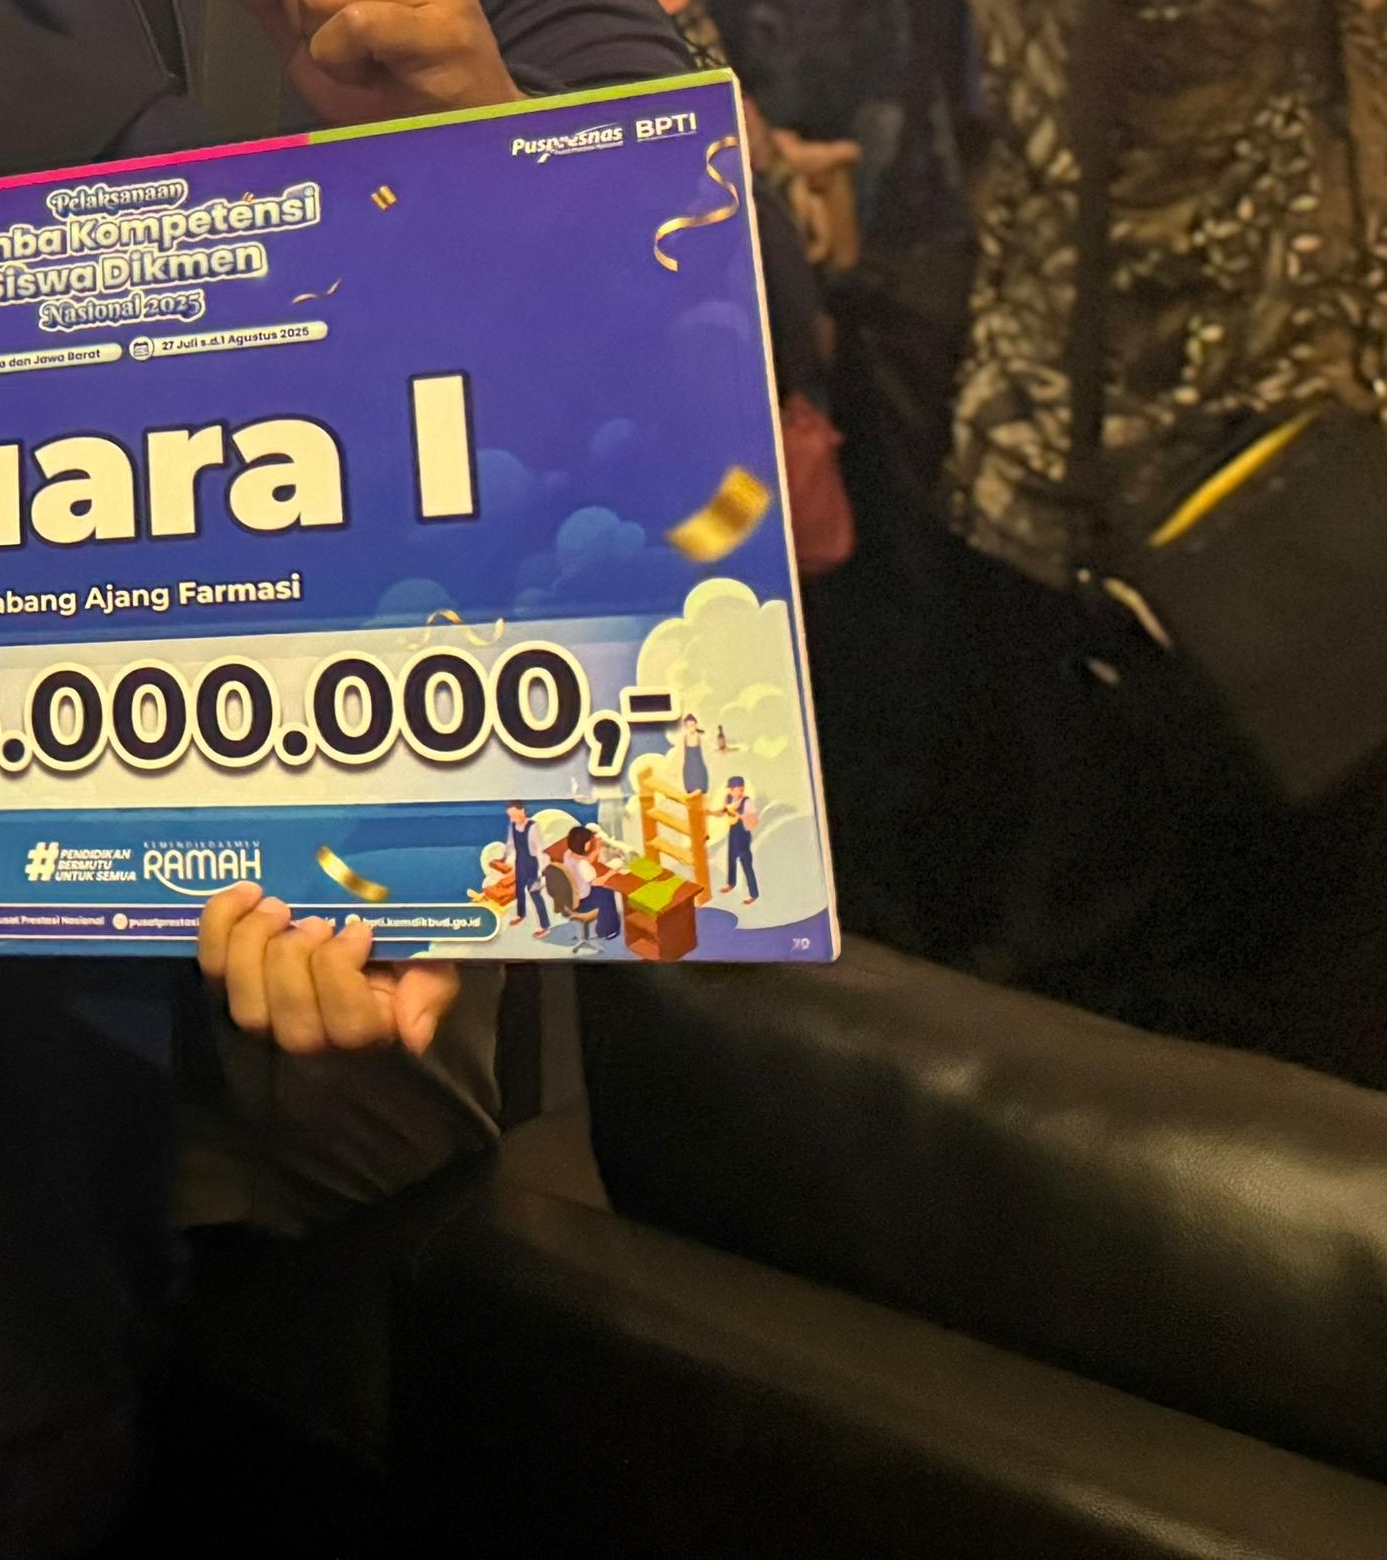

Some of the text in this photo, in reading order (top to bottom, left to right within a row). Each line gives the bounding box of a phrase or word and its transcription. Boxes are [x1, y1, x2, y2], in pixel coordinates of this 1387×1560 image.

[635, 112, 697, 138] BPTI
[50, 181, 185, 217] Pelaksanaan
[70, 188, 318, 252] Kompetensi
[101, 244, 264, 290] Dikmen
[42, 292, 203, 328] Nasional 2025
[162, 340, 174, 351] 27
[176, 338, 198, 350] Juli
[228, 331, 278, 346] Agustus
[9, 357, 32, 368] dan
[34, 354, 65, 365] Jawa
[68, 349, 101, 361] Barat
[411, 374, 475, 518] I
[84, 584, 170, 614] Ajang
[178, 572, 302, 605] Farmasi
[58, 860, 112, 871] BERMUTU
[60, 849, 132, 860] PENDIDIKAN
[143, 848, 261, 880] RAMAH
[55, 871, 136, 881] UNTUK SEMUA
